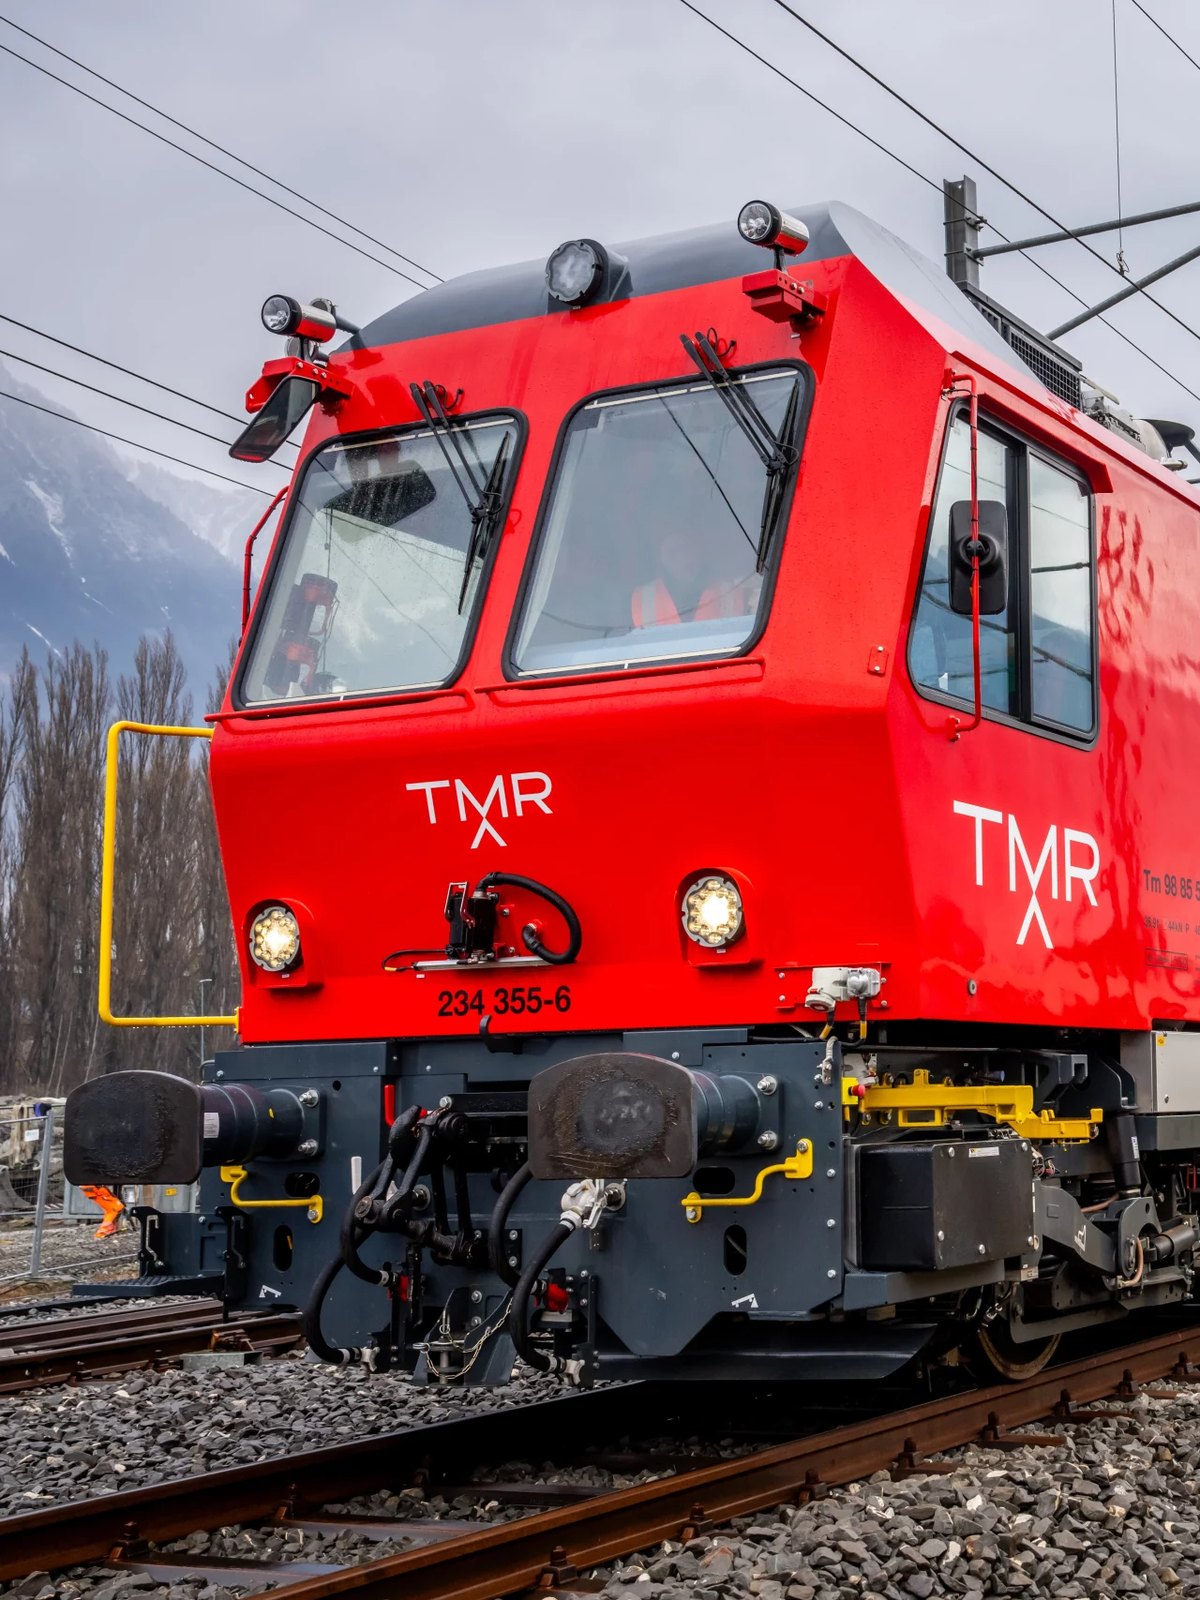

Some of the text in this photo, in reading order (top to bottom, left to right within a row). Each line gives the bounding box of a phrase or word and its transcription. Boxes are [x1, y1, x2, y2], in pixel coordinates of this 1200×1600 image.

[405, 770, 554, 849] TMR
[952, 799, 1101, 949] TMR
[1143, 869, 1162, 893] Tm
[1164, 873, 1178, 897] 98
[1180, 877, 1193, 900] 85
[437, 985, 572, 1017] 234 355-6
